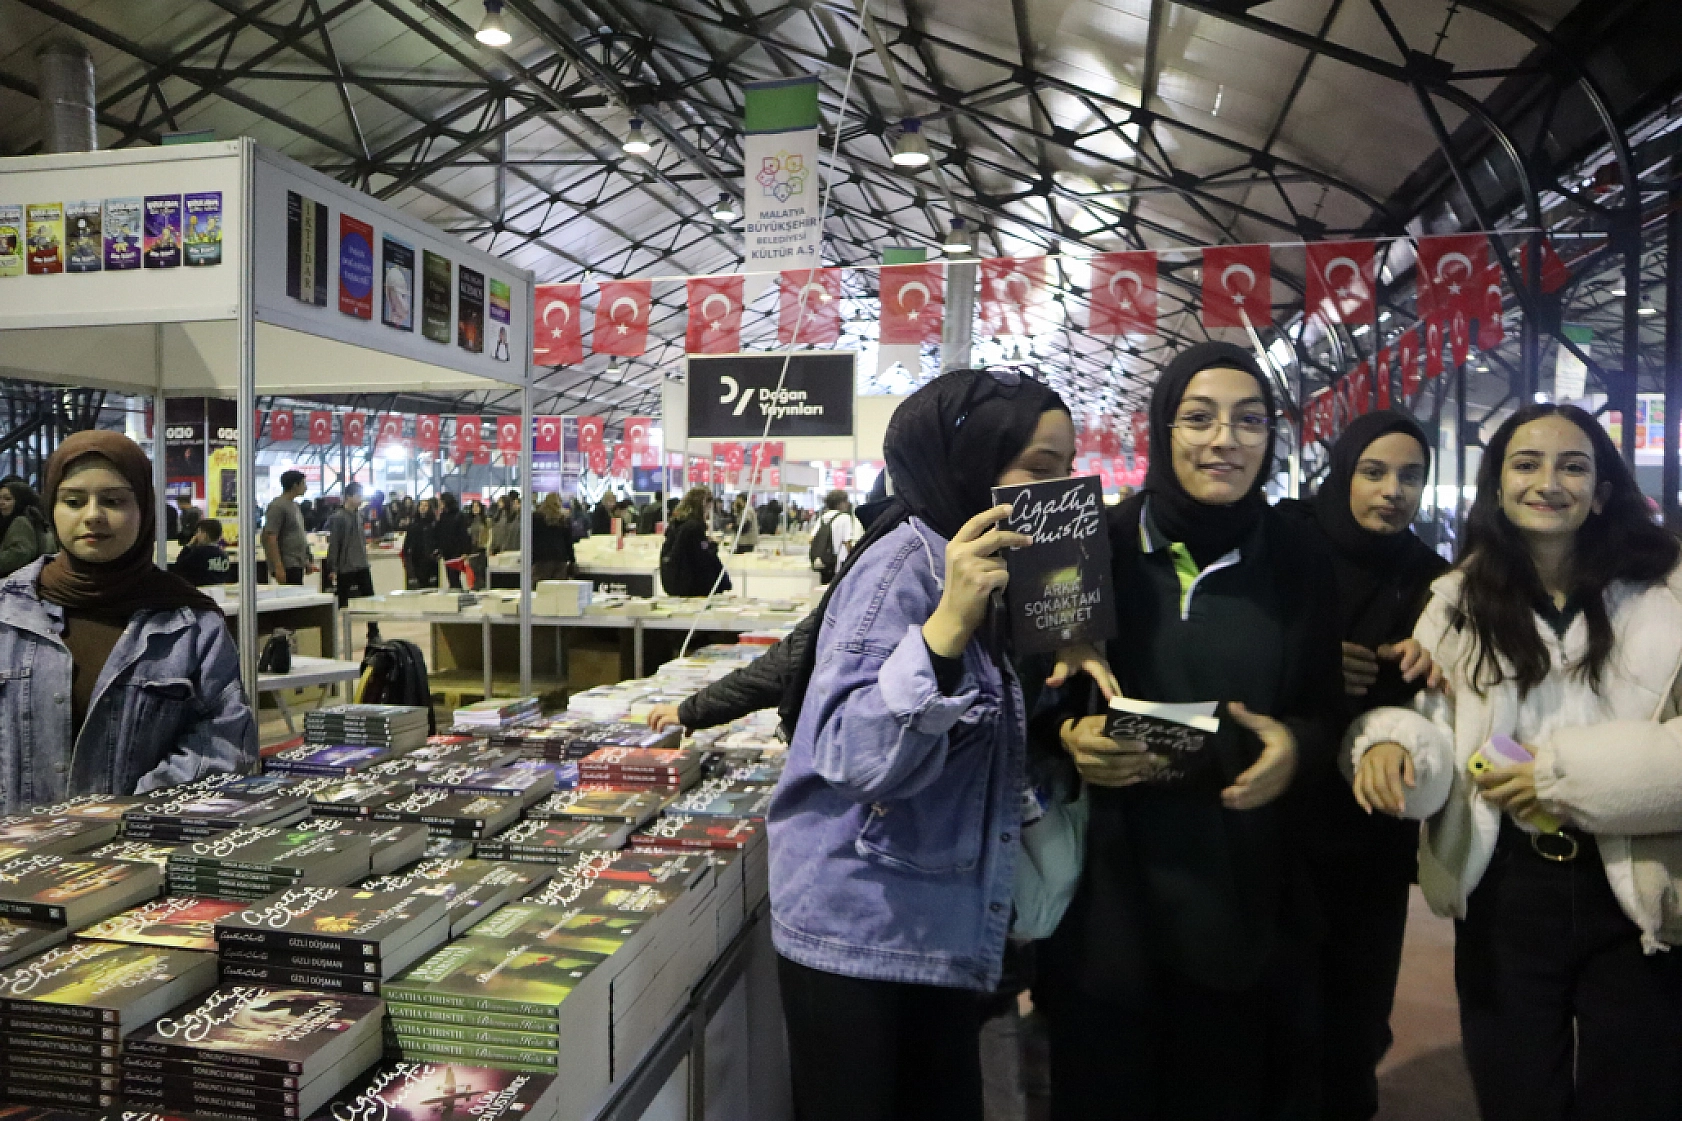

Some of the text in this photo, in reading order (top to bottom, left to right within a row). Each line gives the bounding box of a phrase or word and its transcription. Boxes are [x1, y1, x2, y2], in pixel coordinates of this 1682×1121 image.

[759, 207, 806, 219] MALATYA
[746, 217, 817, 233] BÜYÜKŞEHİR
[756, 233, 807, 245] BELEDİYESİ
[751, 246, 794, 259] KÜLTÜR
[759, 388, 807, 403] Doğan
[759, 402, 824, 419] Yayınları
[1008, 484, 1097, 526] Agatha
[1044, 580, 1081, 598] ARKA
[1024, 588, 1101, 617] SOKAKTAKİ
[1035, 607, 1092, 630] CİNAYET
[289, 938, 341, 951] GİZLİ DÜŞMAN
[291, 956, 343, 970] GİZLİ DÜŞMAN
[291, 974, 342, 988] GİZLİ DÜŞMAN
[198, 1050, 261, 1067] SONUNCU KURBAN
[192, 1065, 256, 1081] SONUNCU KURBAN
[193, 1080, 256, 1097] SONUNCU KURBAN
[193, 1093, 256, 1110] SONUNCU KURBAN
